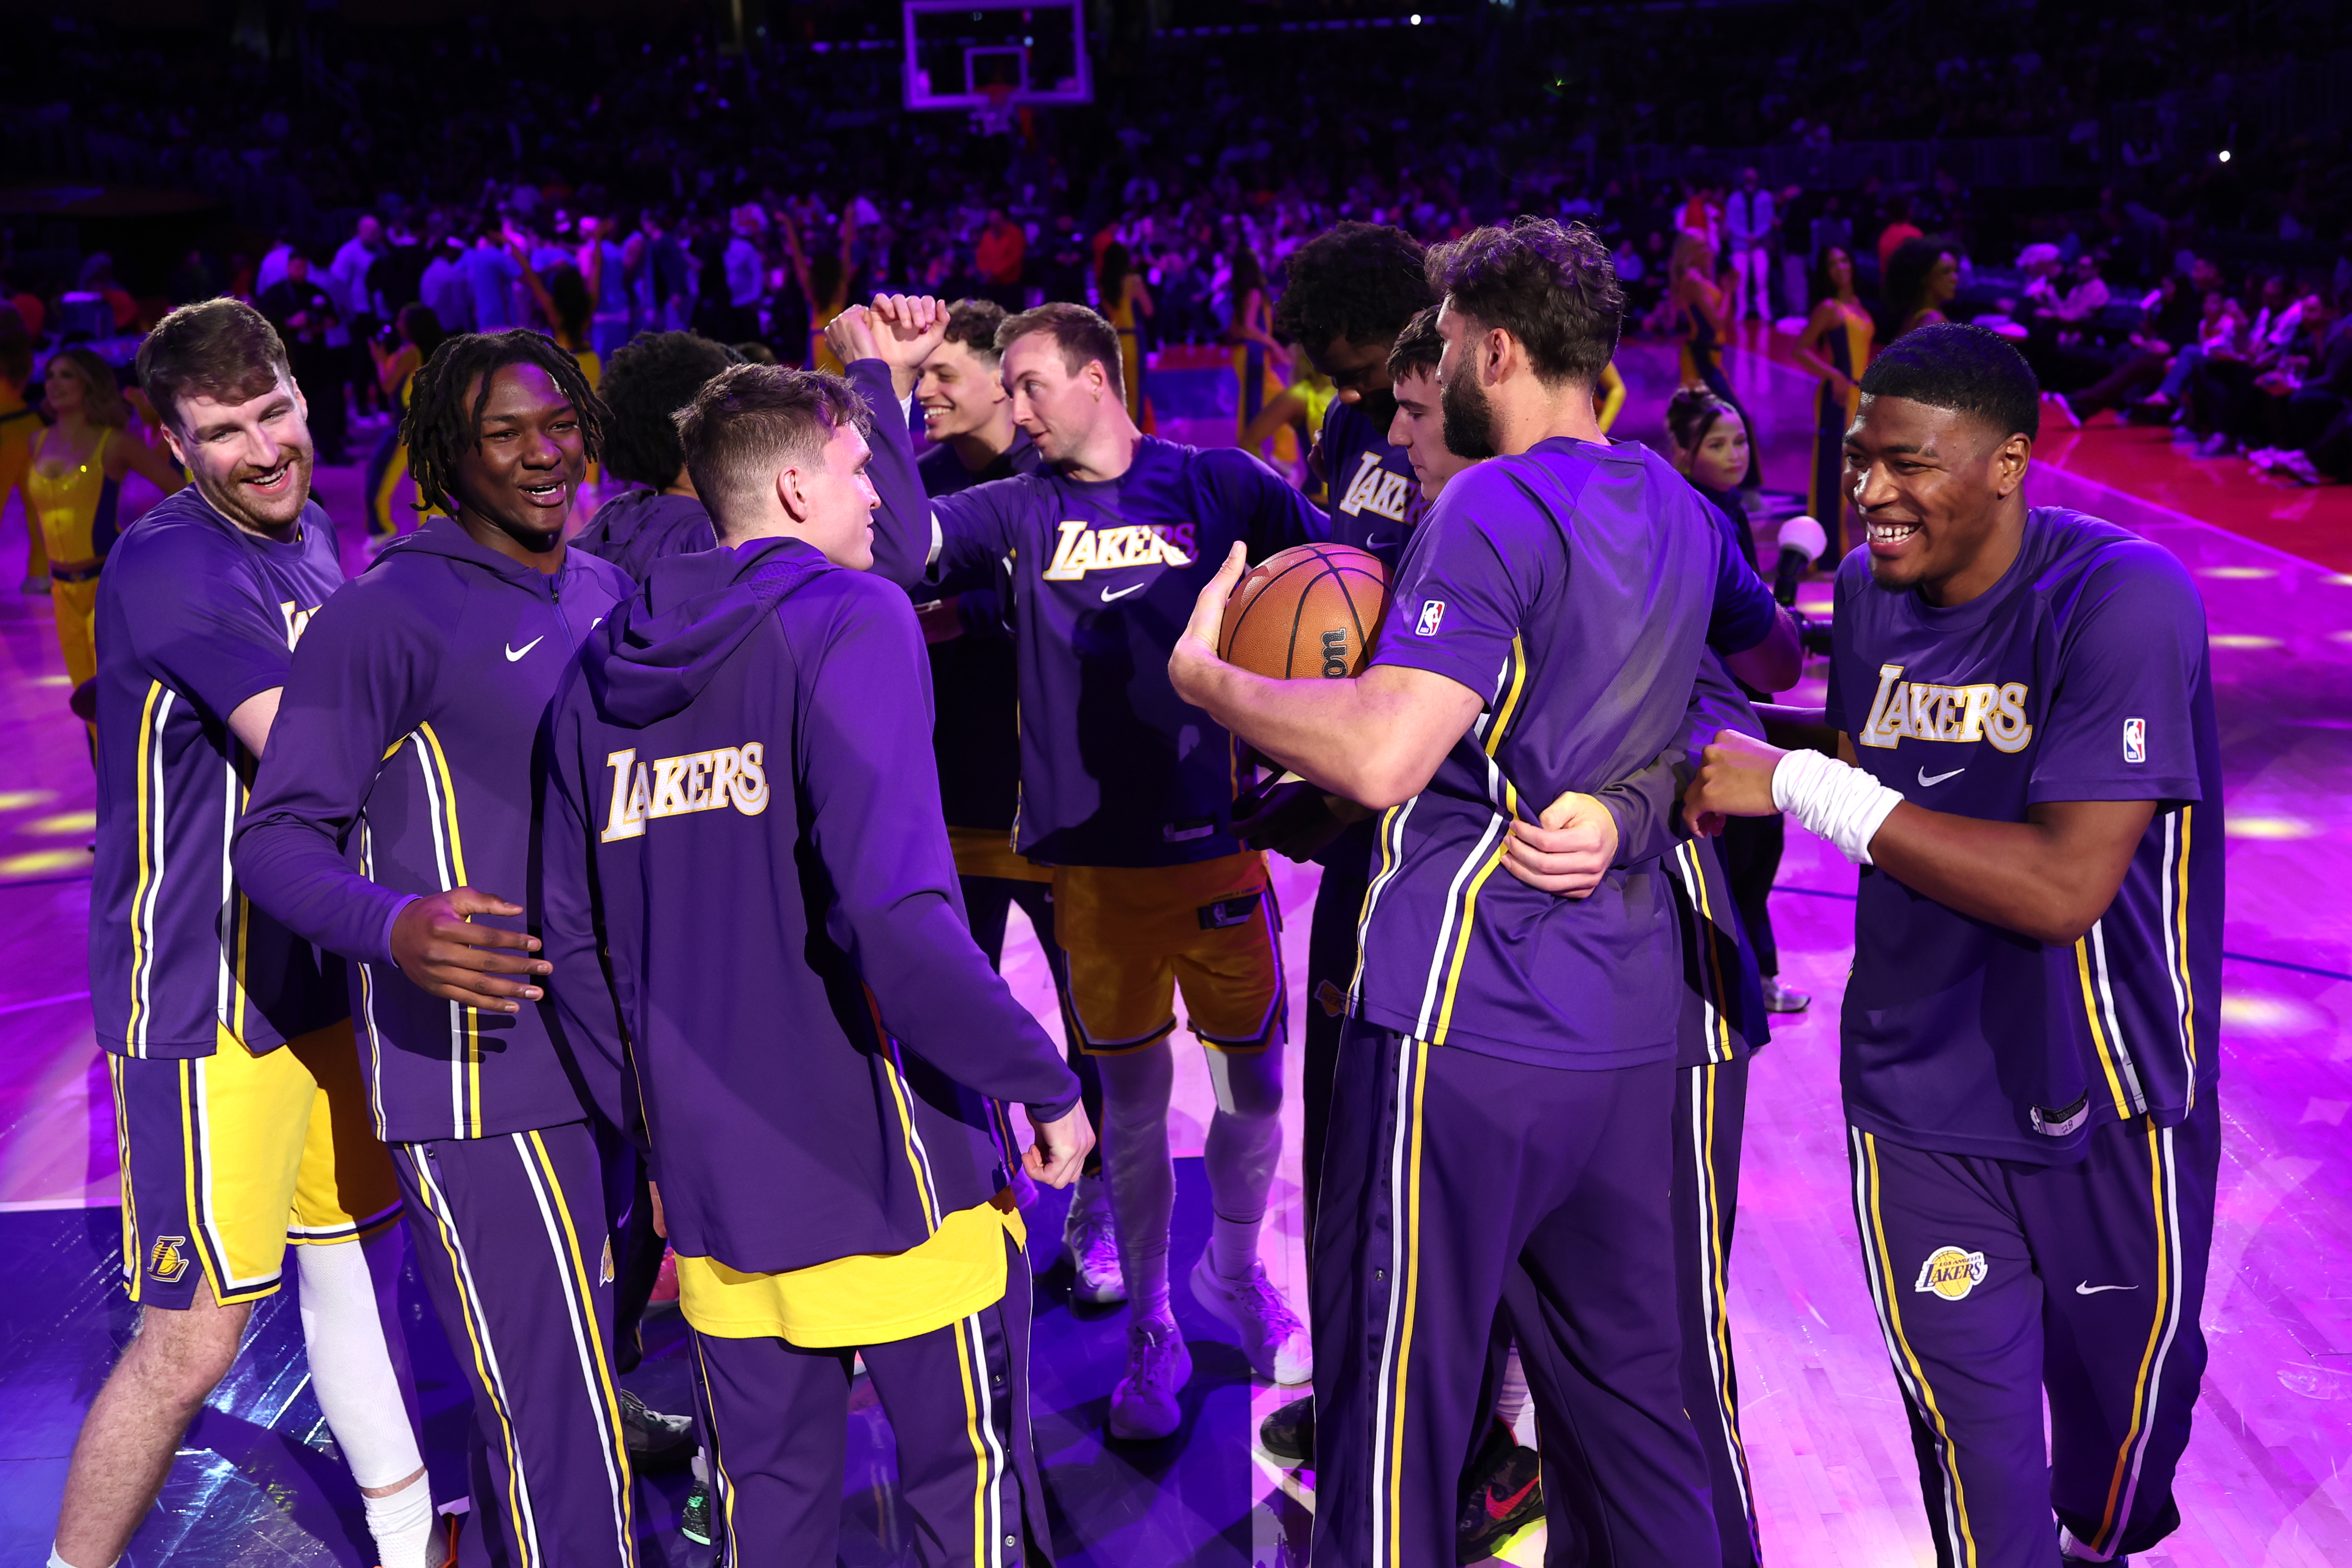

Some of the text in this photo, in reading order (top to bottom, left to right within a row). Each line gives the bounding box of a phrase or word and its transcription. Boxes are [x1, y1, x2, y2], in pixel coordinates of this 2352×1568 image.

[1339, 451, 1431, 526] LAKER
[1042, 521, 1200, 580] LAKERS
[1859, 664, 2032, 753] LAKERS
[601, 741, 770, 843] LAKERS
[1920, 1262, 1985, 1288] LAKERS
[1953, 1255, 1981, 1264] ANGELES
